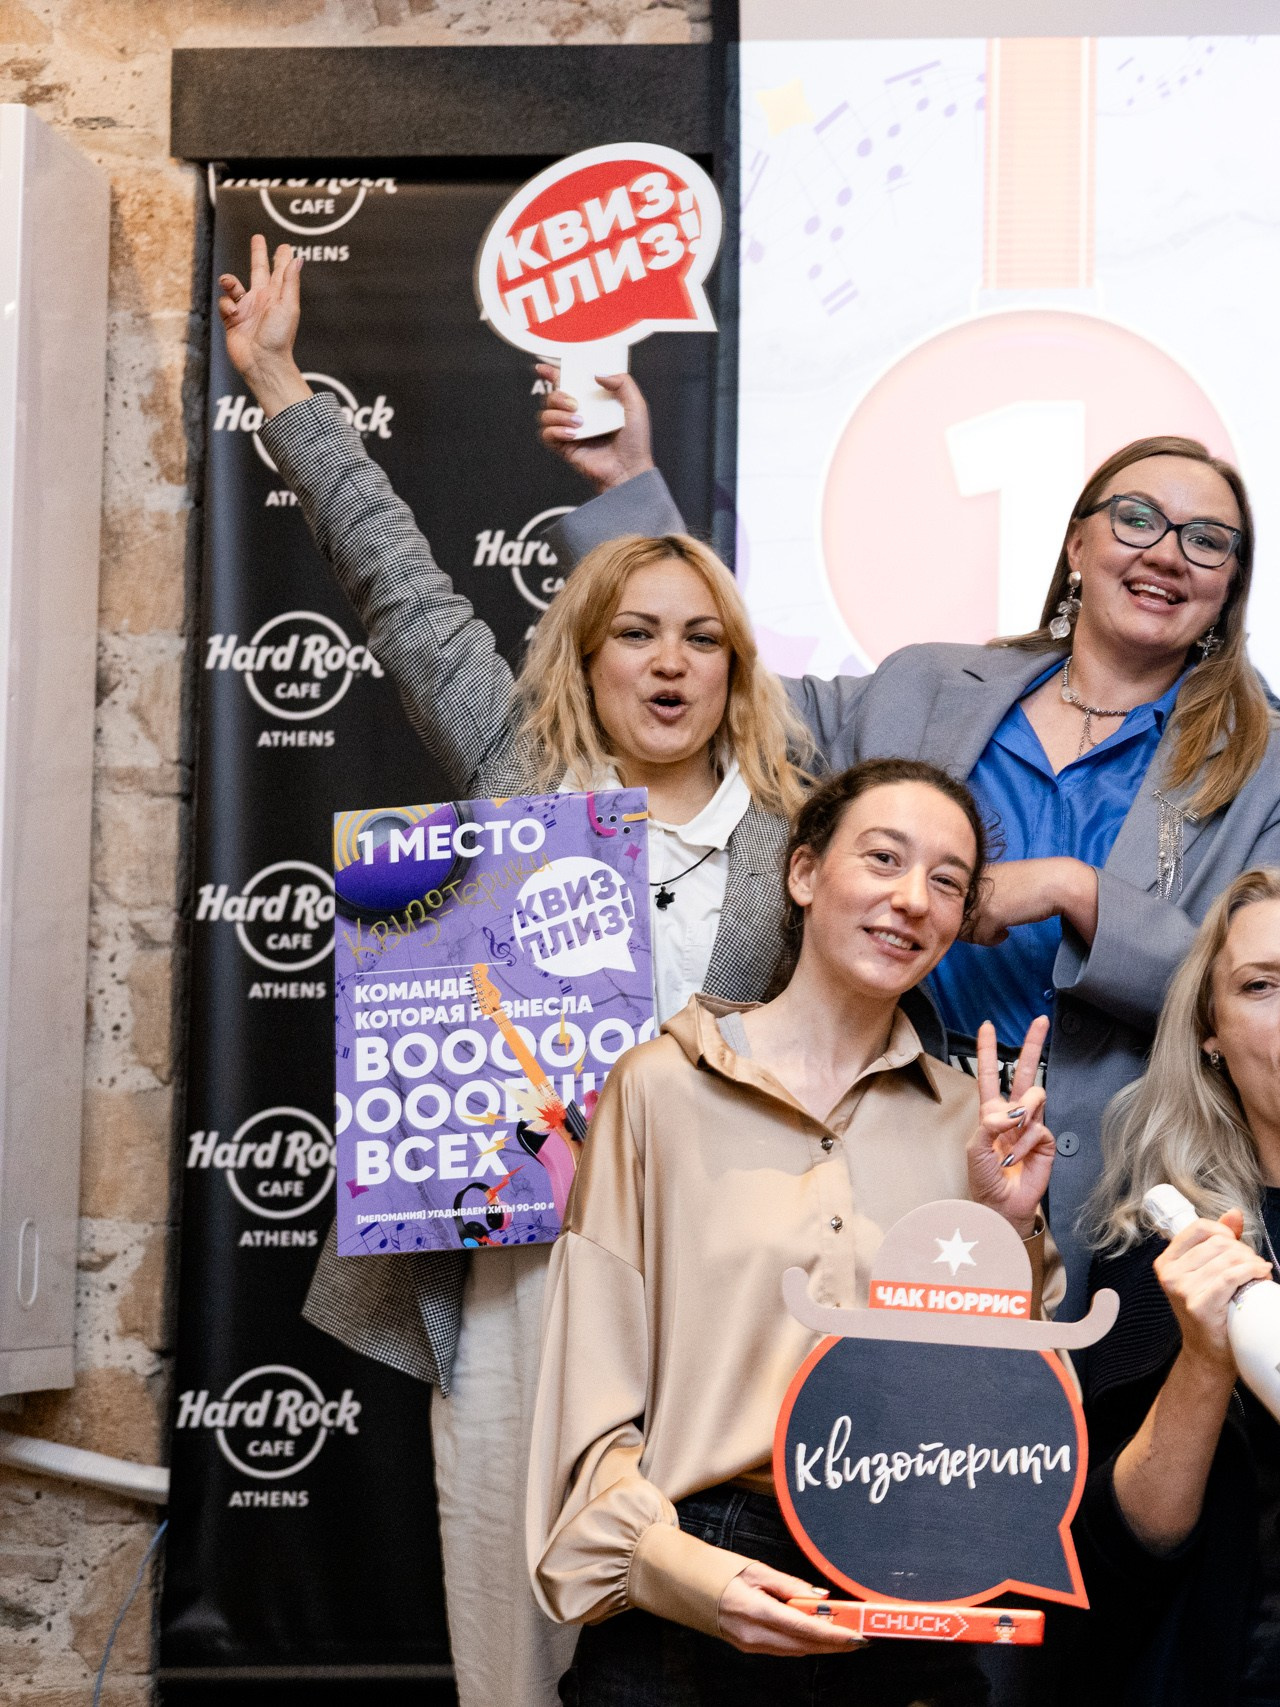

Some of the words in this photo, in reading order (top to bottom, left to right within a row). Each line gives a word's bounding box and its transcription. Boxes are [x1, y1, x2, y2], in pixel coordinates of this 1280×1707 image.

[289, 199, 335, 215] CAFE
[213, 394, 266, 432] Ha
[341, 394, 395, 439] ck
[205, 634, 300, 671] Hard
[275, 682, 321, 699] CAFE
[257, 730, 336, 747] ATHENS
[357, 830, 374, 865] 1
[389, 817, 546, 864] МЕСТО
[196, 884, 291, 922] Hard
[292, 884, 335, 930] Ro
[266, 933, 312, 950] CAFE
[248, 982, 326, 999] ATHENS
[355, 1004, 465, 1029] КОТОРАЯ
[471, 994, 594, 1022] РЗНЕСЛА
[187, 1131, 283, 1169] Hard
[283, 1130, 337, 1177] Ro
[356, 1130, 509, 1186] ВСЕХ
[257, 1181, 304, 1198] CAFE
[357, 1209, 426, 1224] [МЕЛОМАНИЯ]
[427, 1206, 487, 1219] УГАДЫВАЕМ
[487, 1204, 515, 1215] ХИТЫ
[239, 1230, 318, 1247] ATHENS
[876, 1286, 925, 1308] ЧАК
[927, 1290, 1027, 1315] НОРРИС
[176, 1390, 273, 1429] Hard
[273, 1389, 362, 1436] Rock
[247, 1440, 295, 1457] CAFE
[228, 1490, 310, 1508] ATHENS
[870, 1612, 952, 1633] CHUCK
